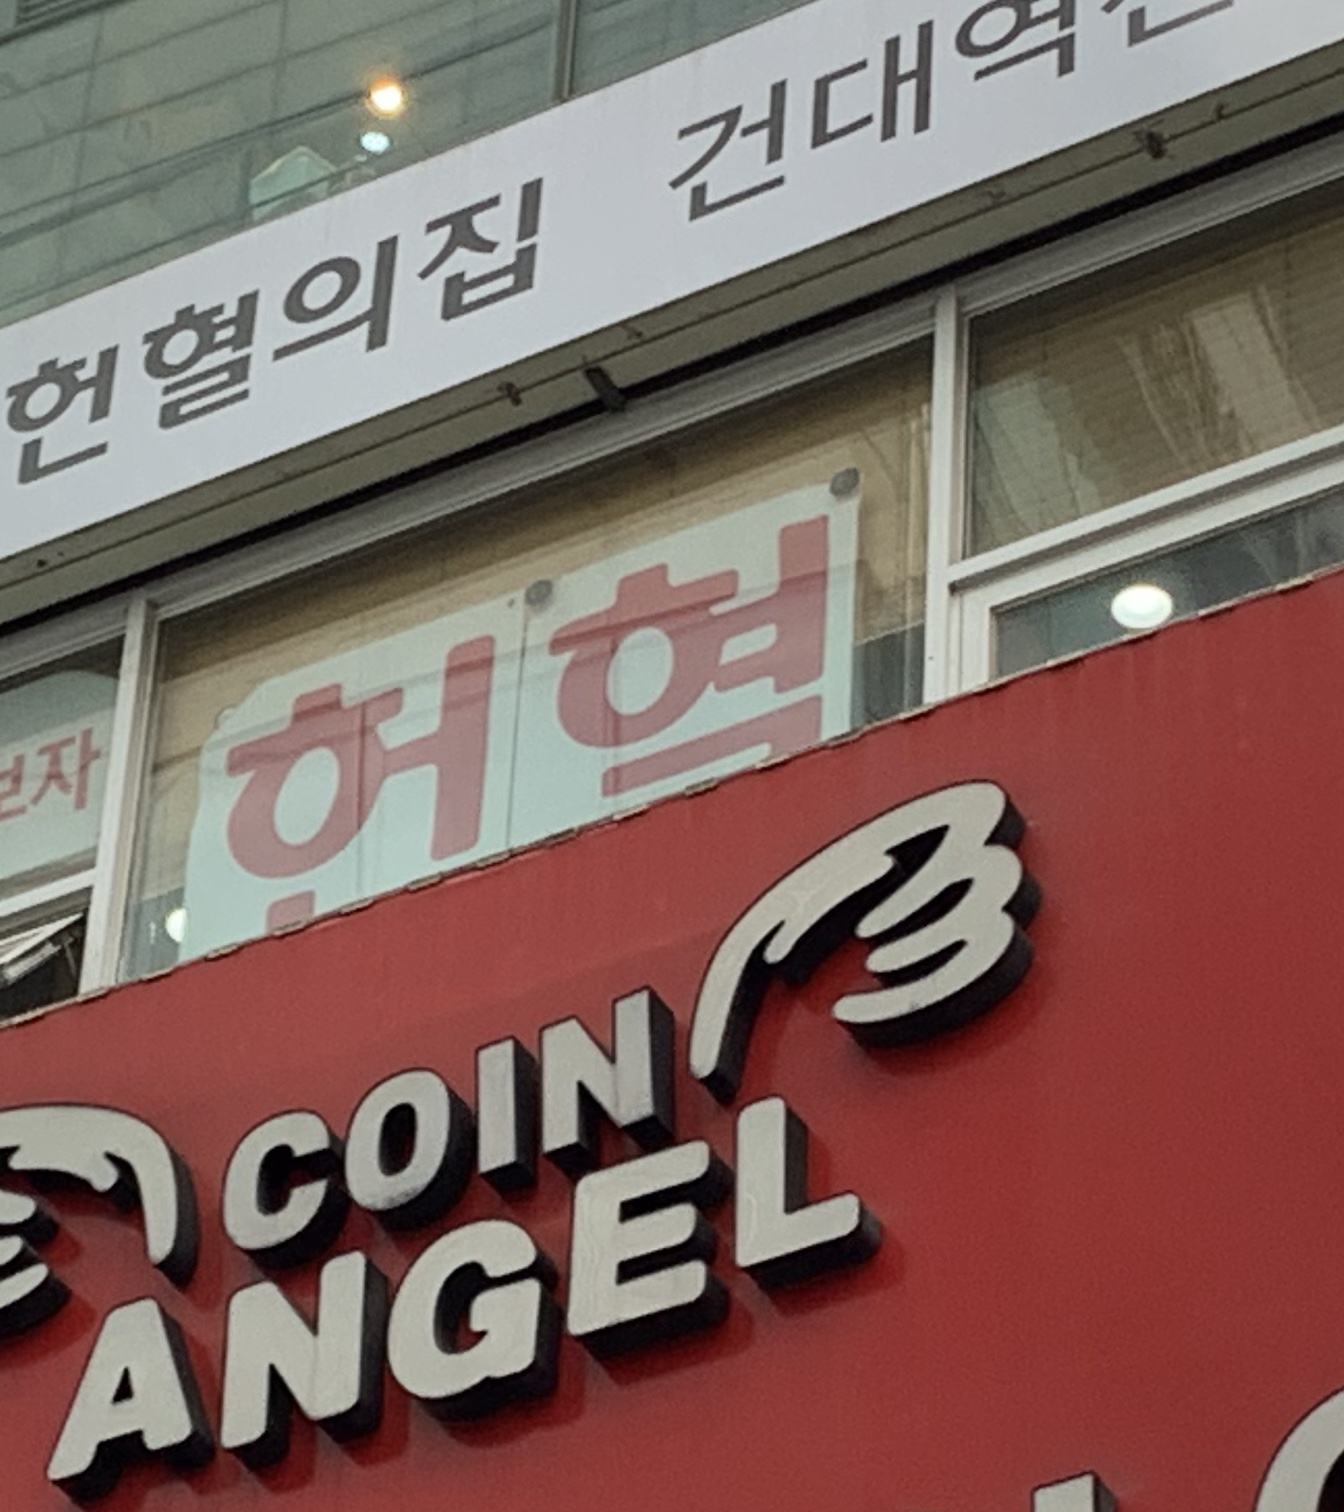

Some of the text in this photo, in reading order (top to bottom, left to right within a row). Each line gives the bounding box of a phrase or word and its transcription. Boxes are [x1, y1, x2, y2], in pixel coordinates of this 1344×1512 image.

[6, 177, 544, 486] 헌혈의집
[222, 986, 673, 1258] COIN
[47, 1096, 878, 1502] ANGEL
